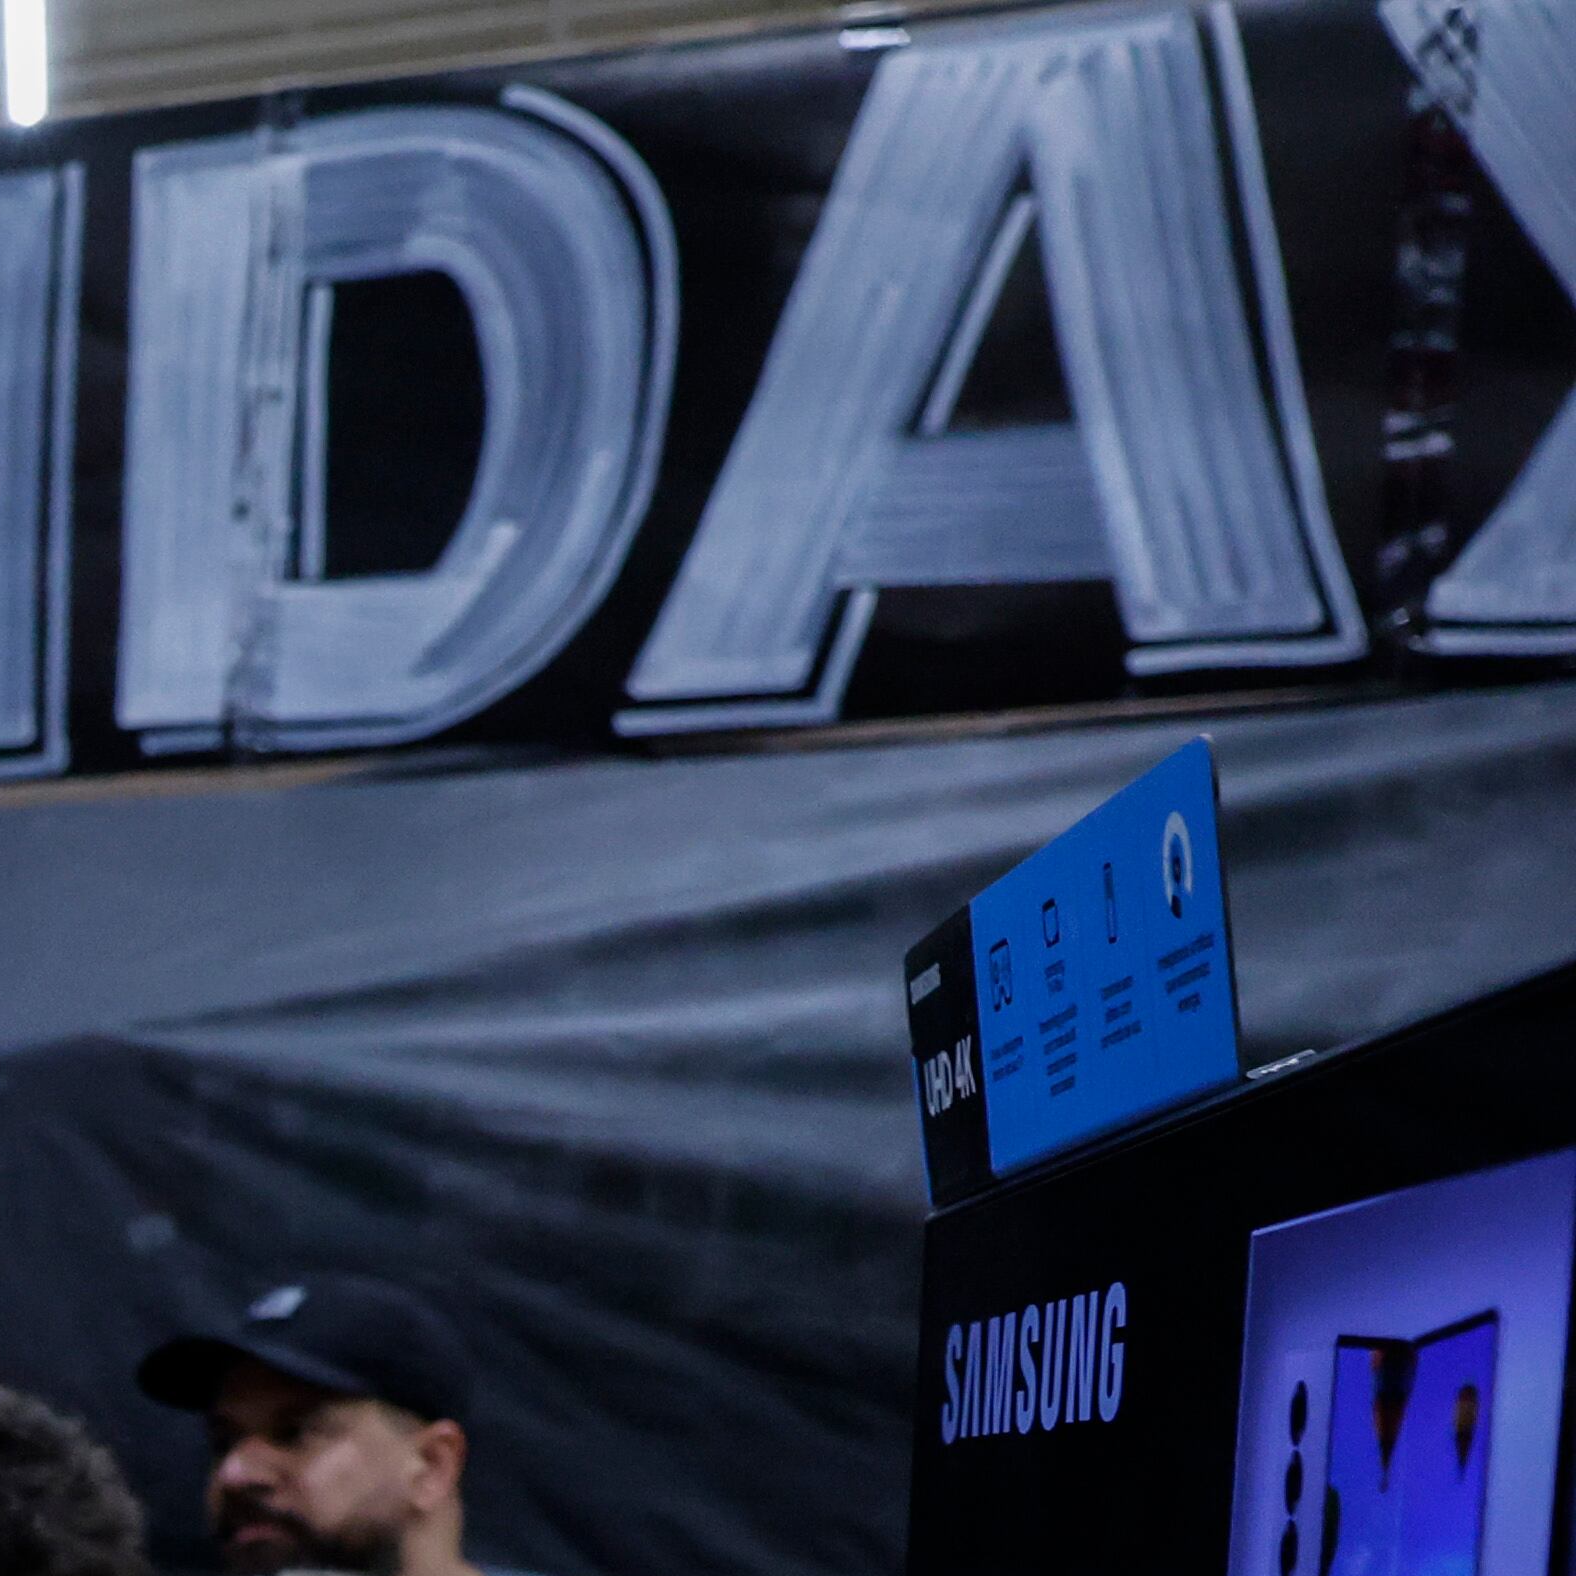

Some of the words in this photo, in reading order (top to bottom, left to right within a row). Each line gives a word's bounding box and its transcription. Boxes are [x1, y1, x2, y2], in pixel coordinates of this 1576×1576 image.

[923, 1049, 953, 1118] UHD
[955, 1033, 977, 1100] 4K
[941, 1282, 1127, 1445] SAMSUNG
